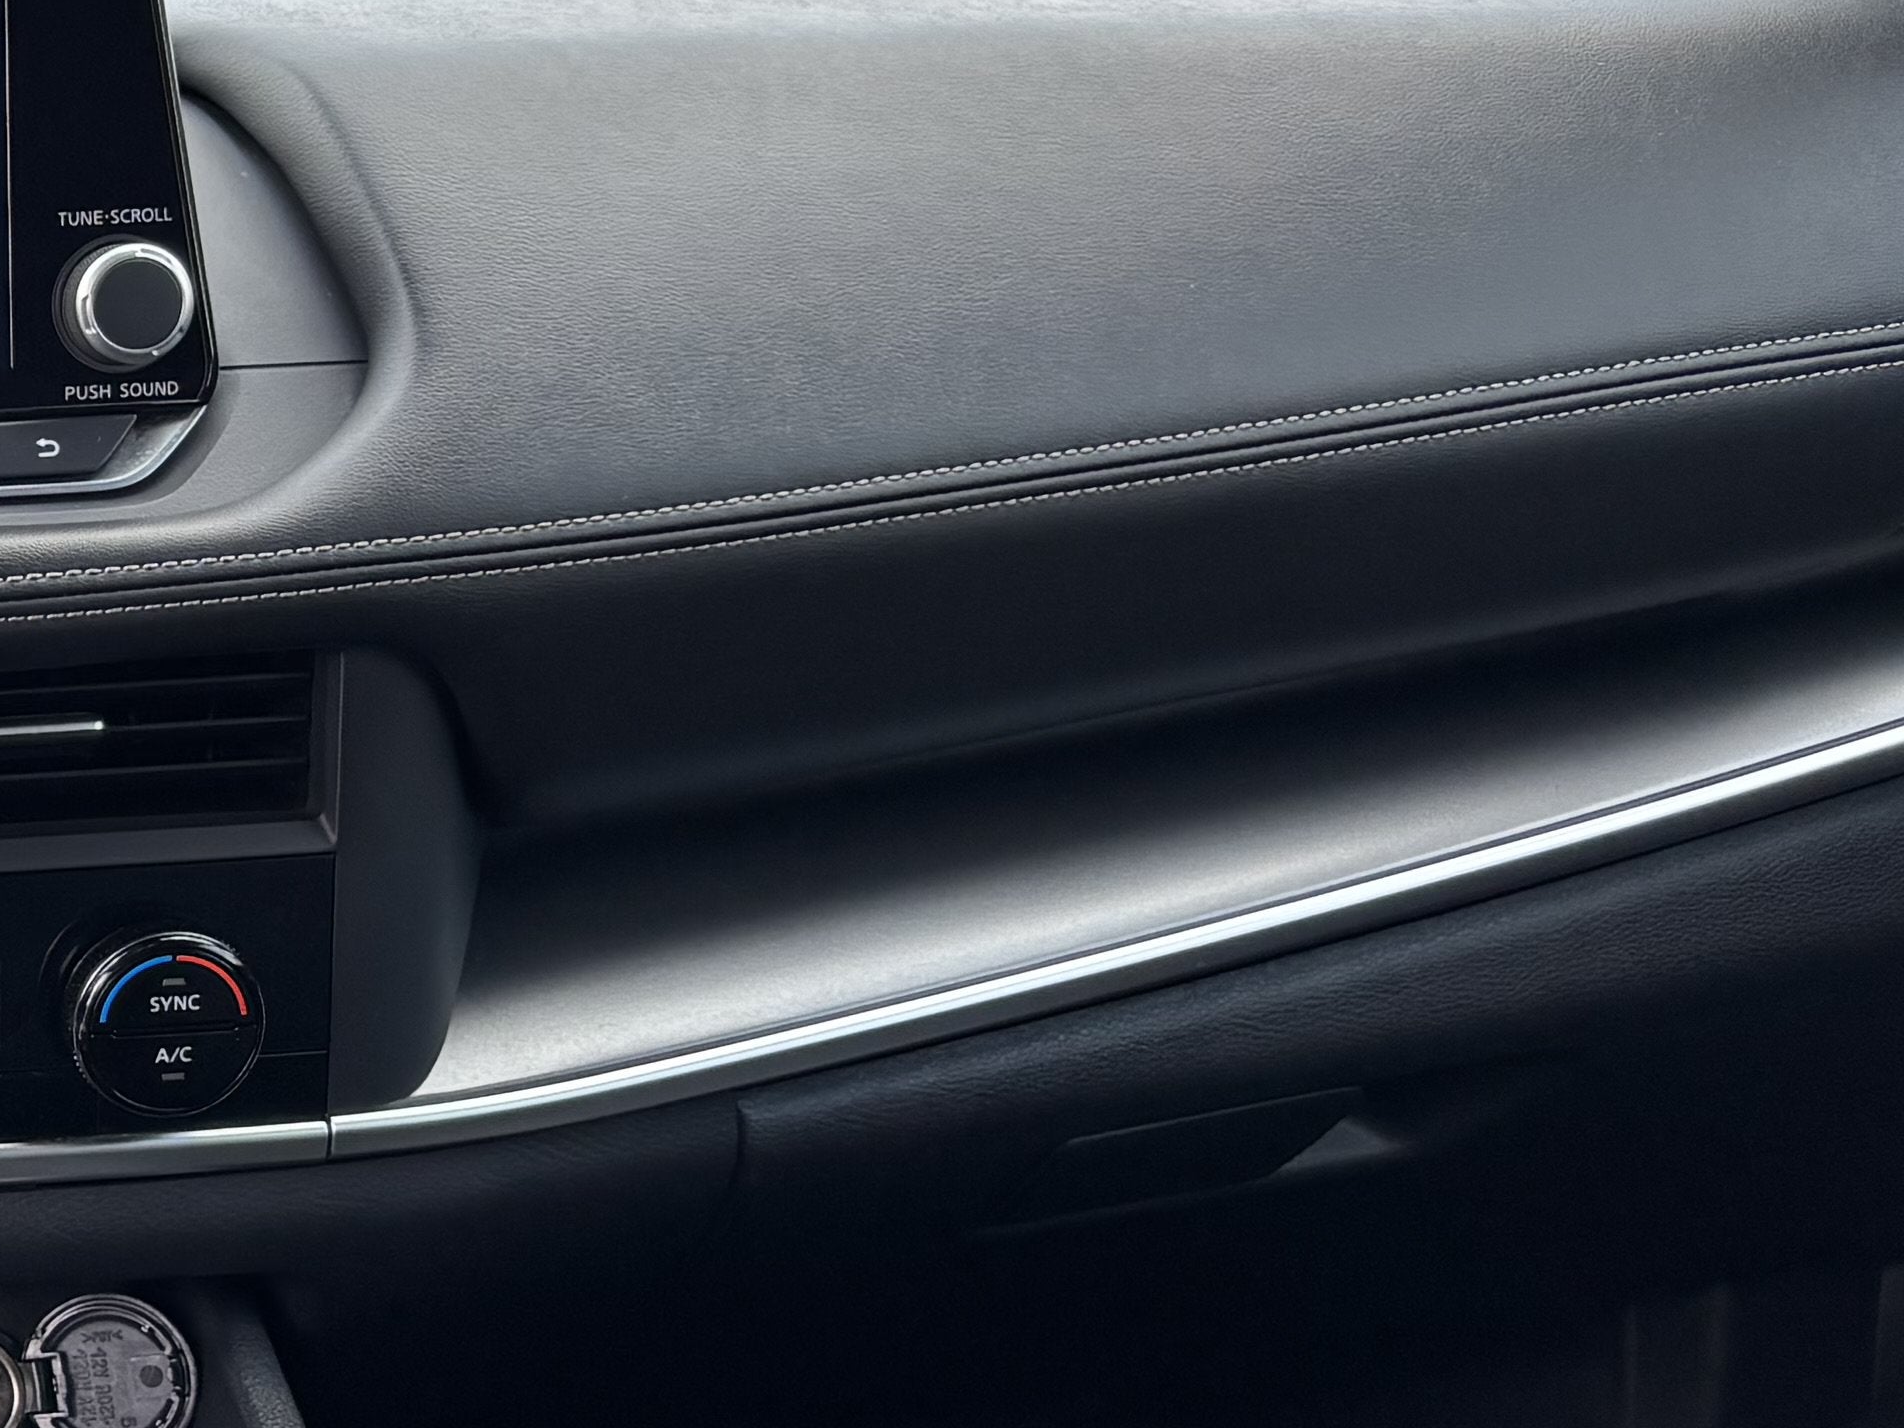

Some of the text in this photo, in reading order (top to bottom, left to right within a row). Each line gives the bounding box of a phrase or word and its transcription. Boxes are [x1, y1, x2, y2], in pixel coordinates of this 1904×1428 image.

[63, 380, 180, 401] PUSH SOUND
[149, 994, 201, 1013] SYNC
[155, 1045, 193, 1064] A/C
